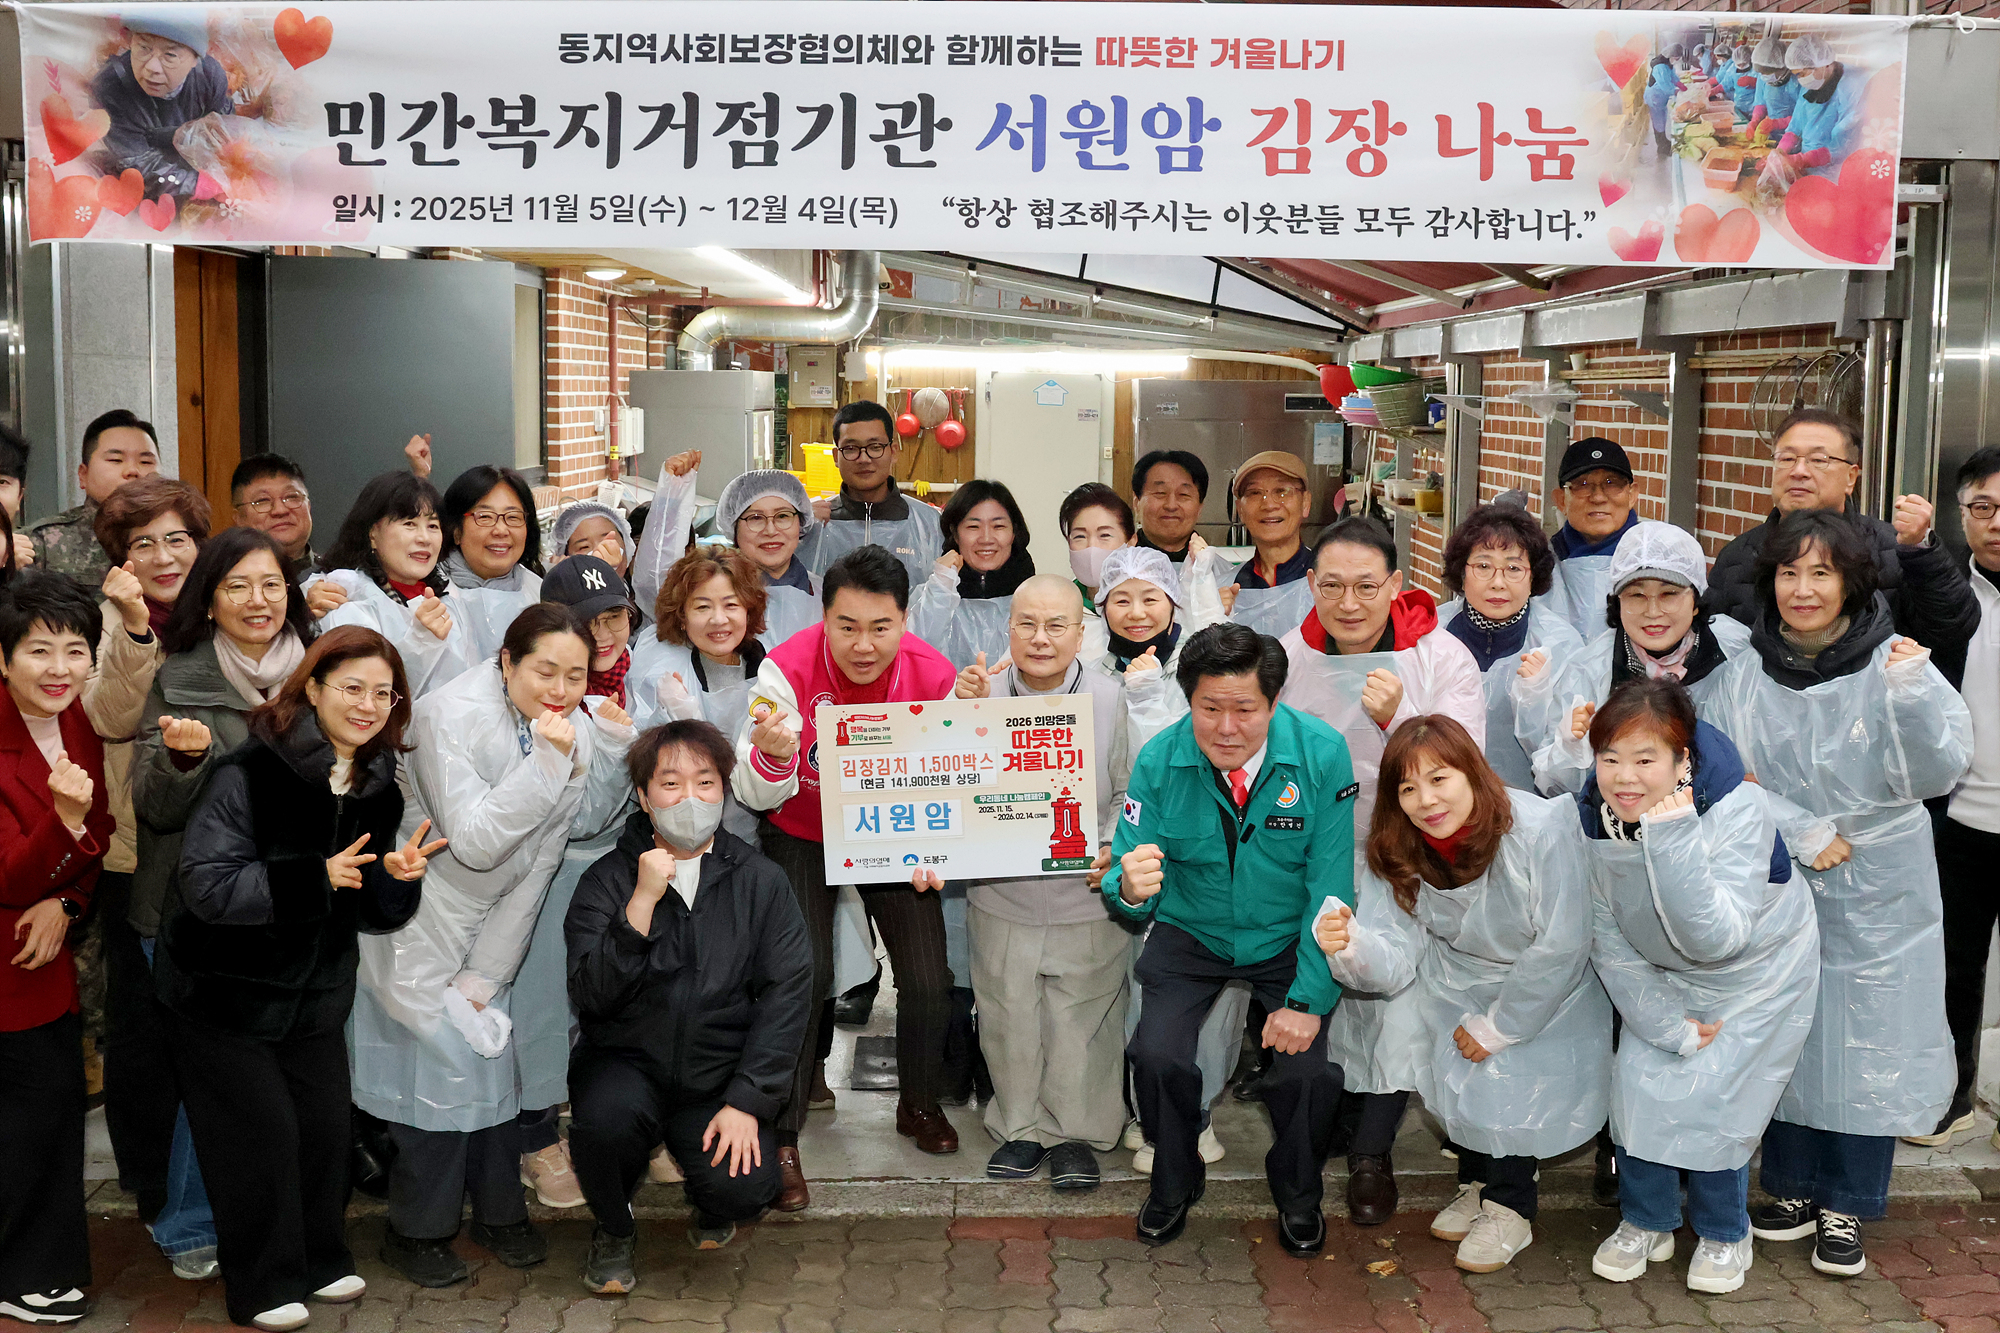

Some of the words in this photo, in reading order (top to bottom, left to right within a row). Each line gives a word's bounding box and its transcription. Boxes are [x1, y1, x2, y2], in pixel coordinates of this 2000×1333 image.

[559, 34, 934, 65] 동지역사회보장협의체와
[947, 35, 1082, 66] 함께하는
[1097, 37, 1197, 68] 따뜻한
[1211, 39, 1344, 70] 겨울나기
[324, 92, 952, 170] 민간복지거점기관
[976, 94, 1221, 174] 서원암
[1247, 99, 1407, 177] 김장
[1436, 103, 1589, 181] 나눔
[333, 194, 383, 223] 일시
[411, 194, 512, 222] 2025년
[524, 194, 577, 222] 11월
[590, 195, 686, 226] 5일(수)
[728, 195, 786, 223] 12월
[798, 196, 897, 228] 4일(목)
[943, 197, 1017, 228] “항상
[1028, 198, 1211, 232] 협조해주시는
[1224, 202, 1344, 235] 이웃분들
[1354, 208, 1414, 237] 모두
[1425, 207, 1595, 241] 감사합니다.”
[582, 568, 607, 590] NY
[1006, 717, 1032, 727] 2026
[1034, 713, 1077, 726] 희망온돌
[1011, 727, 1074, 749] 따뜻한
[843, 757, 908, 778] 김장김치
[920, 753, 993, 773] 1,500박스
[1002, 748, 1084, 772] 겨울나기
[890, 774, 951, 788] 141,900천원
[855, 803, 951, 833] 서원암
[923, 855, 949, 864] 도봉구
